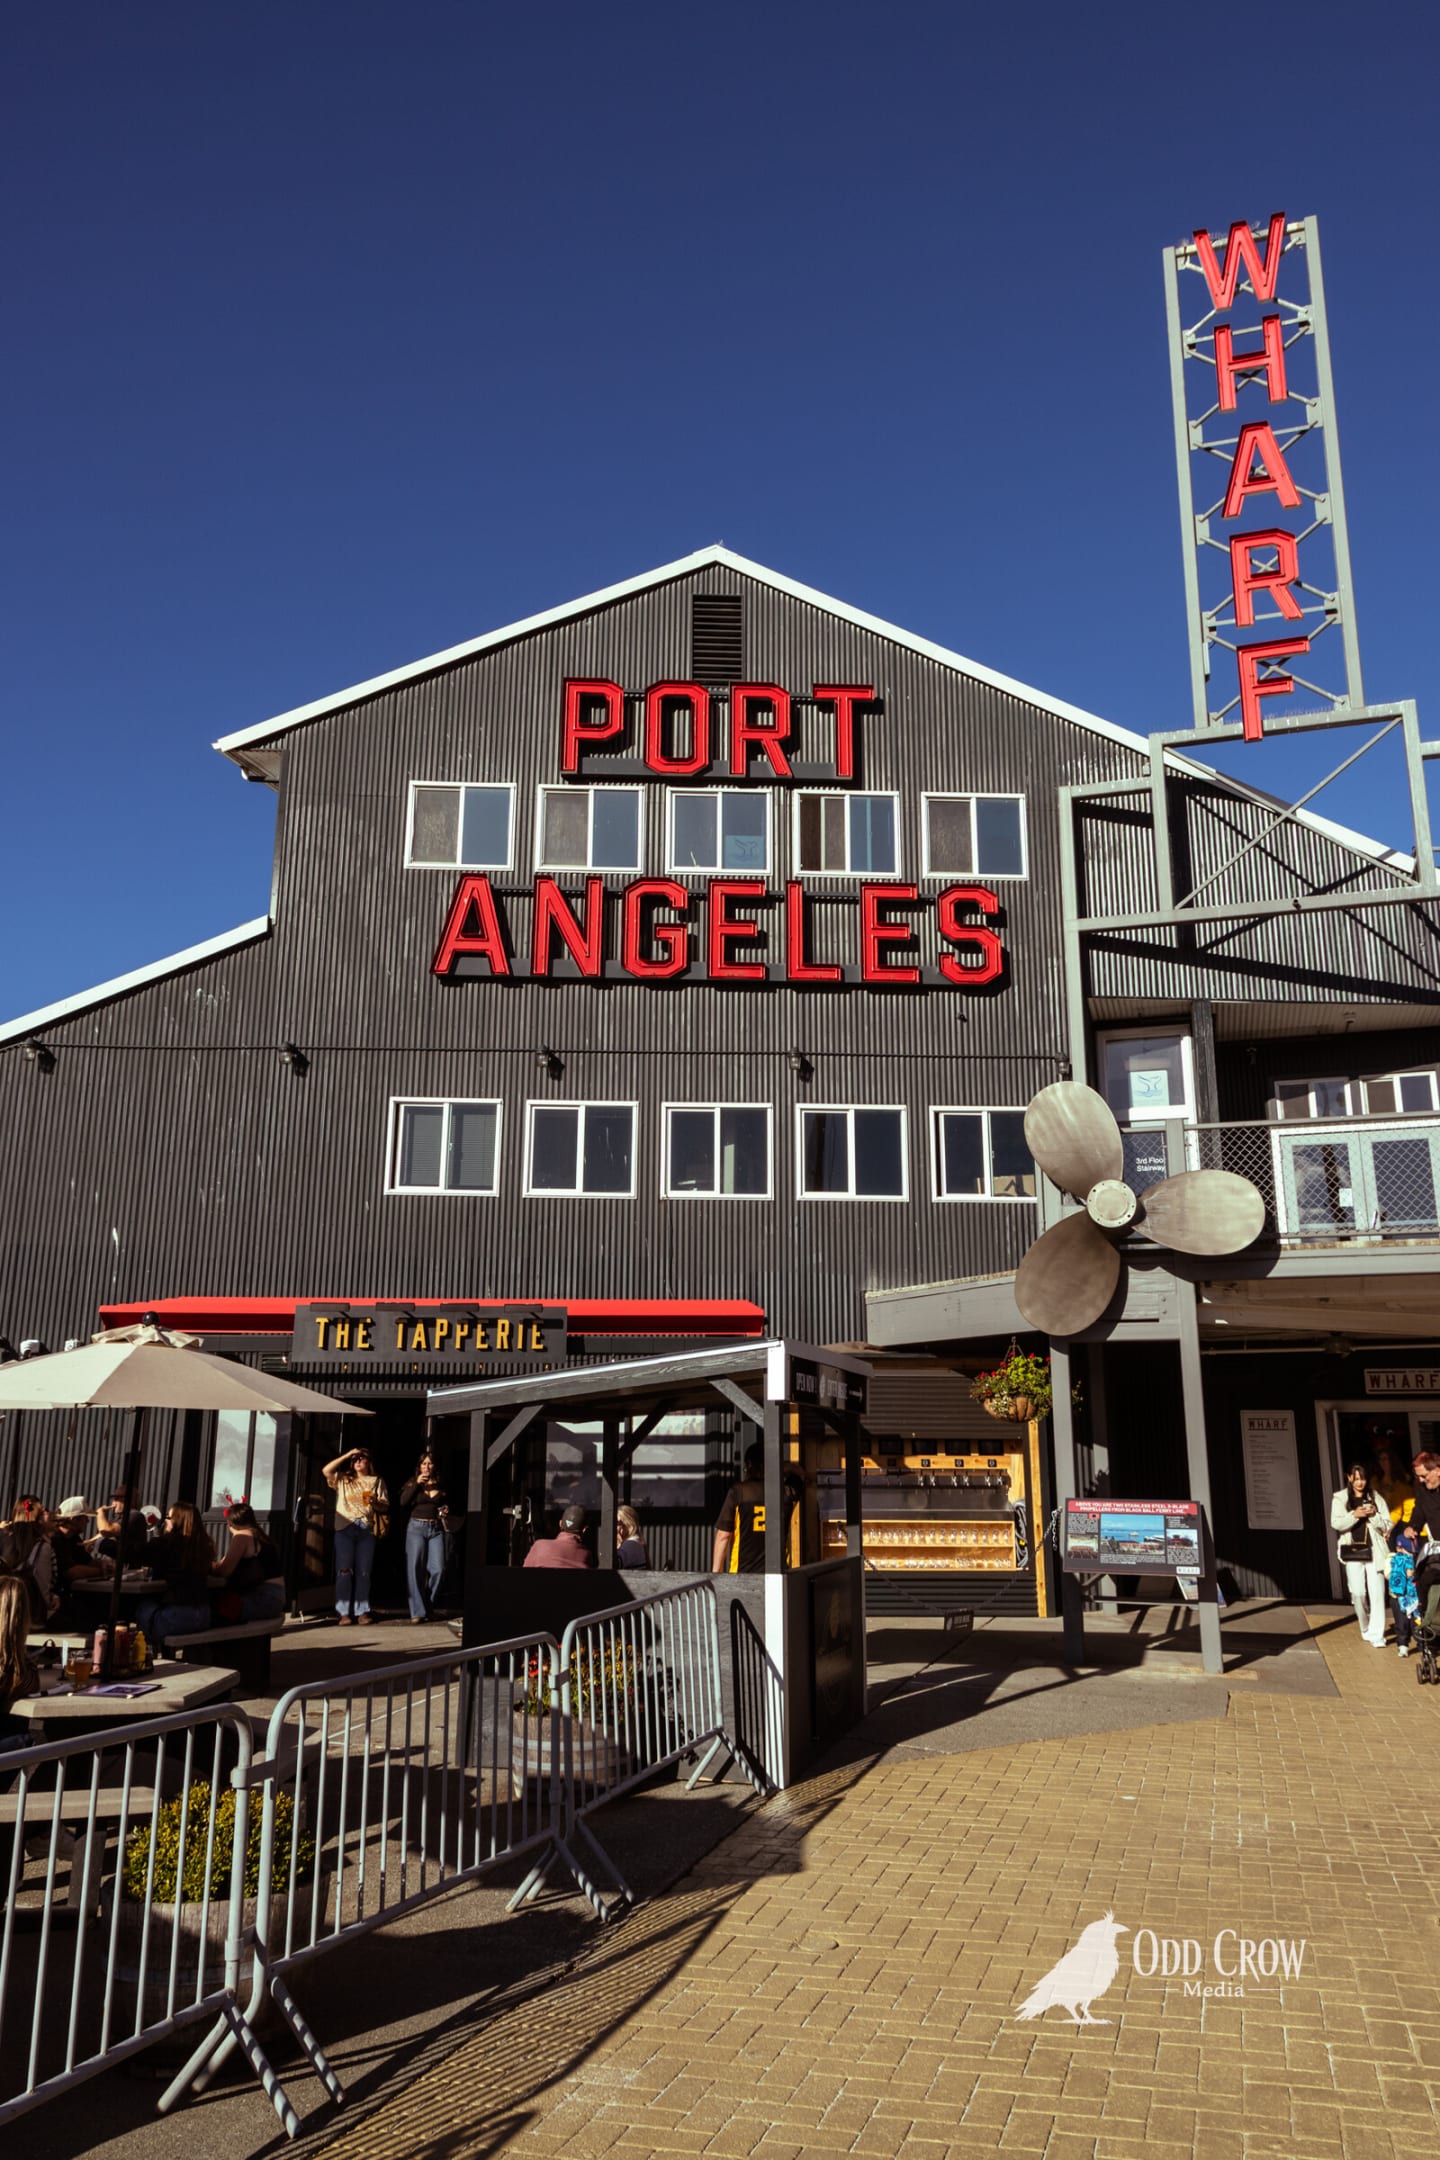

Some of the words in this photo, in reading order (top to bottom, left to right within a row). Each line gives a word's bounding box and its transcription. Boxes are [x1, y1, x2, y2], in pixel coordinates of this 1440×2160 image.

[1192, 211, 1311, 742] WHARF
[561, 677, 874, 778] PORT
[430, 872, 1004, 985] ANGELES
[316, 1317, 372, 1349] THE
[395, 1318, 544, 1350] TAPPERIE
[1369, 1374, 1440, 1388] WHARF
[1248, 1420, 1288, 1429] WHARF
